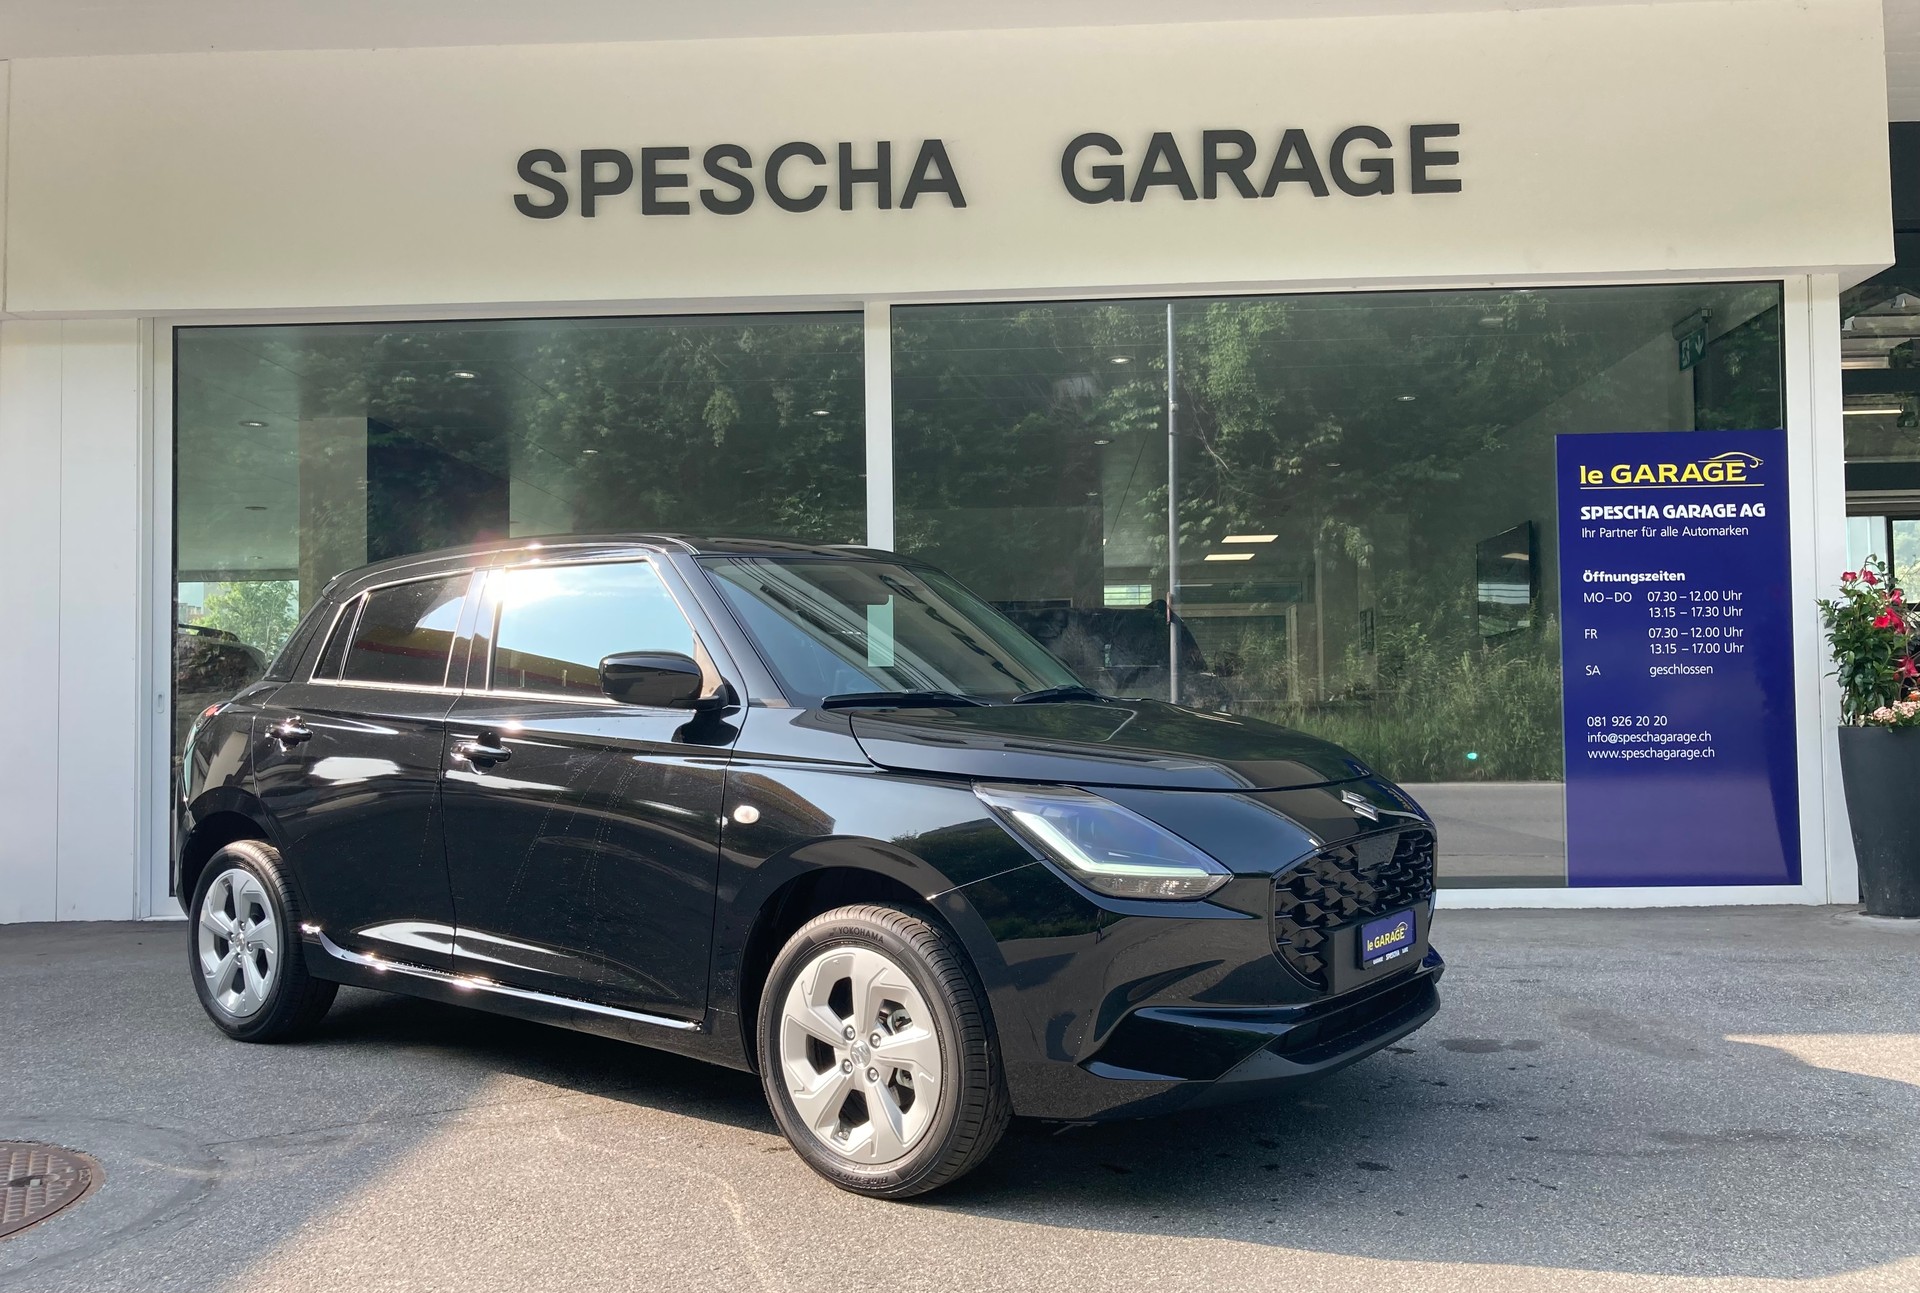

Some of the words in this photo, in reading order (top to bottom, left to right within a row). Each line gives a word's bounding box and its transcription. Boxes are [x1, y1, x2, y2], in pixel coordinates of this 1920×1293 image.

[514, 139, 967, 219] SPESCHA
[1061, 124, 1462, 204] GARAGE
[1580, 466, 1603, 484] le
[1611, 463, 1747, 484] GARAGE
[1581, 505, 1659, 520] SPESCHA
[1663, 504, 1736, 518] GARAGE
[1740, 503, 1765, 517] AG
[1582, 527, 1595, 537] Ihr
[1600, 528, 1638, 537] Partner
[1641, 526, 1656, 537] für
[1661, 526, 1678, 537] alle
[1682, 525, 1748, 536] Automarken
[1583, 570, 1685, 584] Öffnungszeiten
[1648, 591, 1677, 602] 07.30
[1690, 591, 1718, 601] 12.00
[1723, 590, 1742, 601] Uhr
[1649, 607, 1675, 617] 13.15
[1692, 607, 1719, 617] 17.30
[1723, 606, 1743, 616] Uhr
[1585, 629, 1597, 639] FR
[1649, 628, 1678, 638] 07.30
[1691, 627, 1719, 637] 12.00
[1724, 626, 1743, 637] Uhr
[1650, 644, 1676, 654] 13.15
[1692, 643, 1720, 653] 17.00
[1725, 642, 1744, 653] Uhr
[1586, 665, 1600, 675] SA
[1650, 664, 1713, 677] geschlossen
[1587, 716, 1606, 727] 081
[1612, 716, 1632, 726] 926
[1636, 716, 1649, 726] 20
[1654, 716, 1667, 726] 20
[1588, 731, 1711, 744] info@speschagarage.ch
[1588, 747, 1714, 760] www.speschagarage.ch
[839, 926, 884, 944] YOKOHAMA
[1367, 940, 1374, 951] le
[1374, 928, 1405, 948] GARAGE
